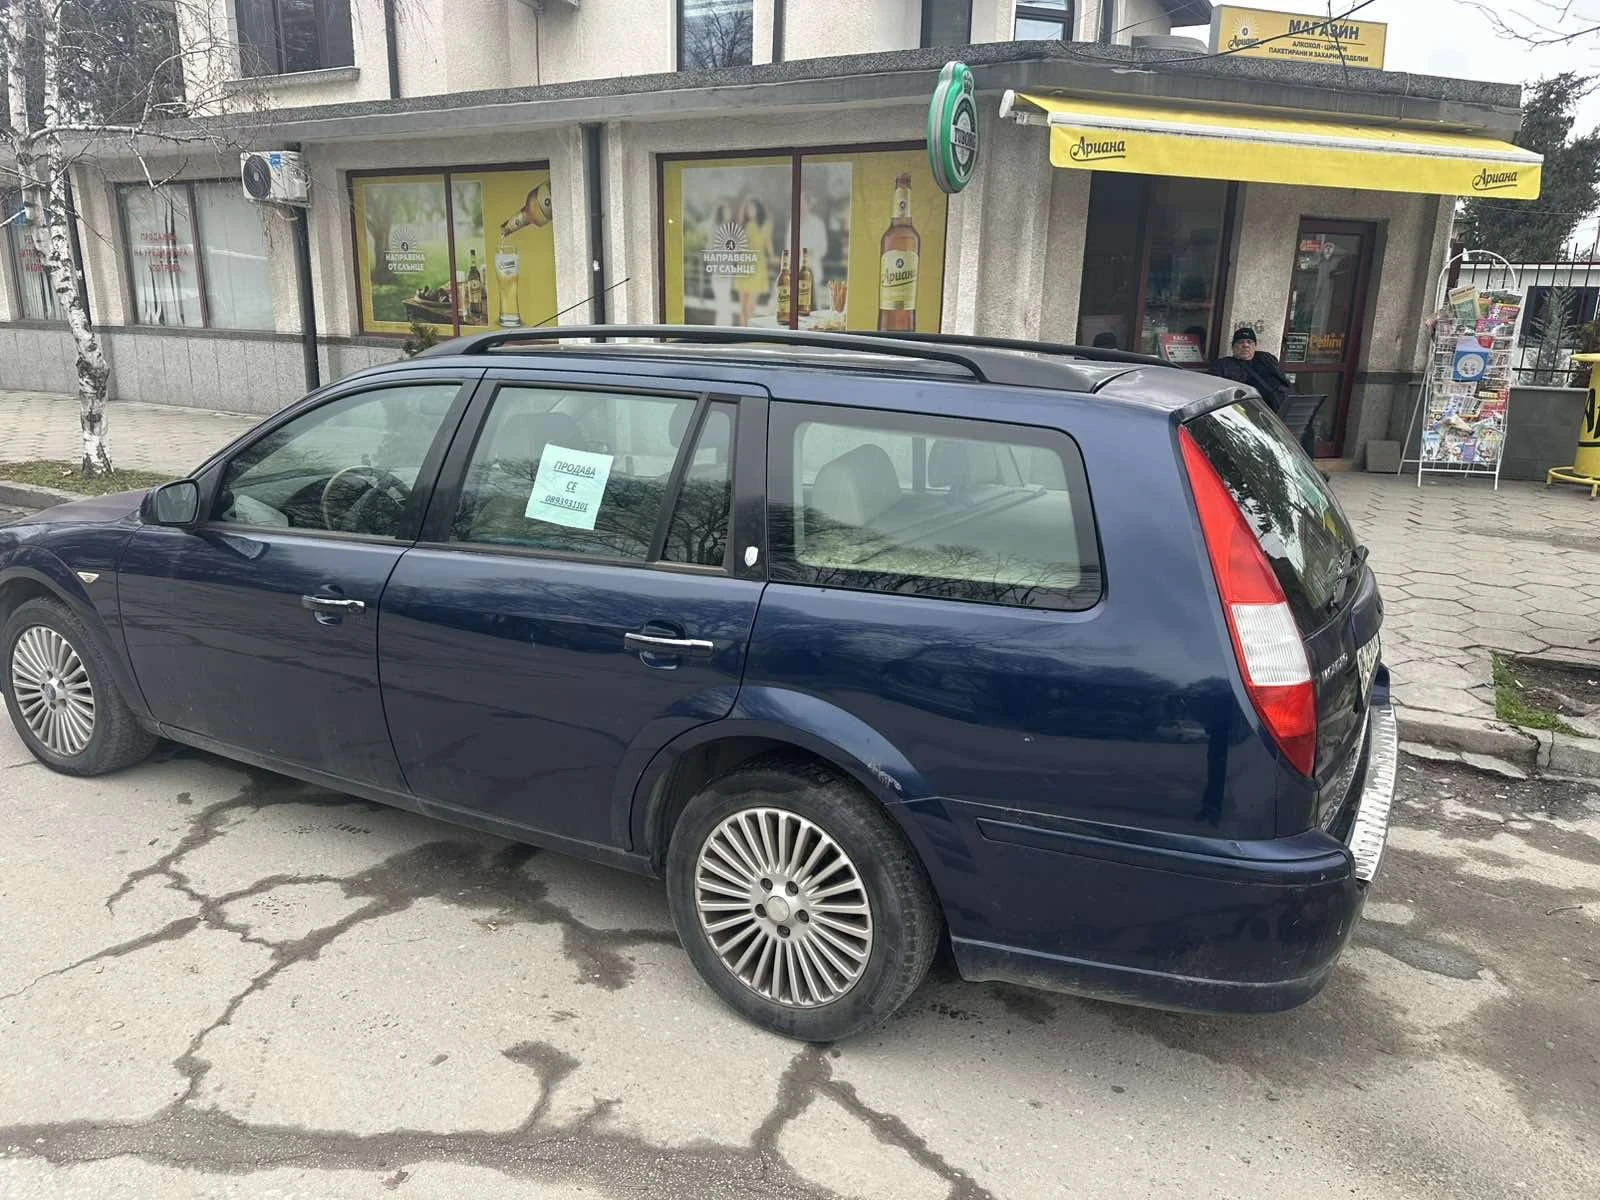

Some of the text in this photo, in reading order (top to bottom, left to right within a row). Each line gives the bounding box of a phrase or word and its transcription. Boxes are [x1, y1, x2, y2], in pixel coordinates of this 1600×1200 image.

[1288, 19, 1360, 41] МАГАЗИН
[1070, 136, 1126, 161] Ариана
[1472, 168, 1518, 191] Ариана
[703, 253, 758, 262] НАПРАВЕНА
[705, 264, 756, 273] ОТ СЛЪНЦЕ
[554, 460, 596, 478] ПРОДАВА
[565, 481, 578, 492] СЕ
